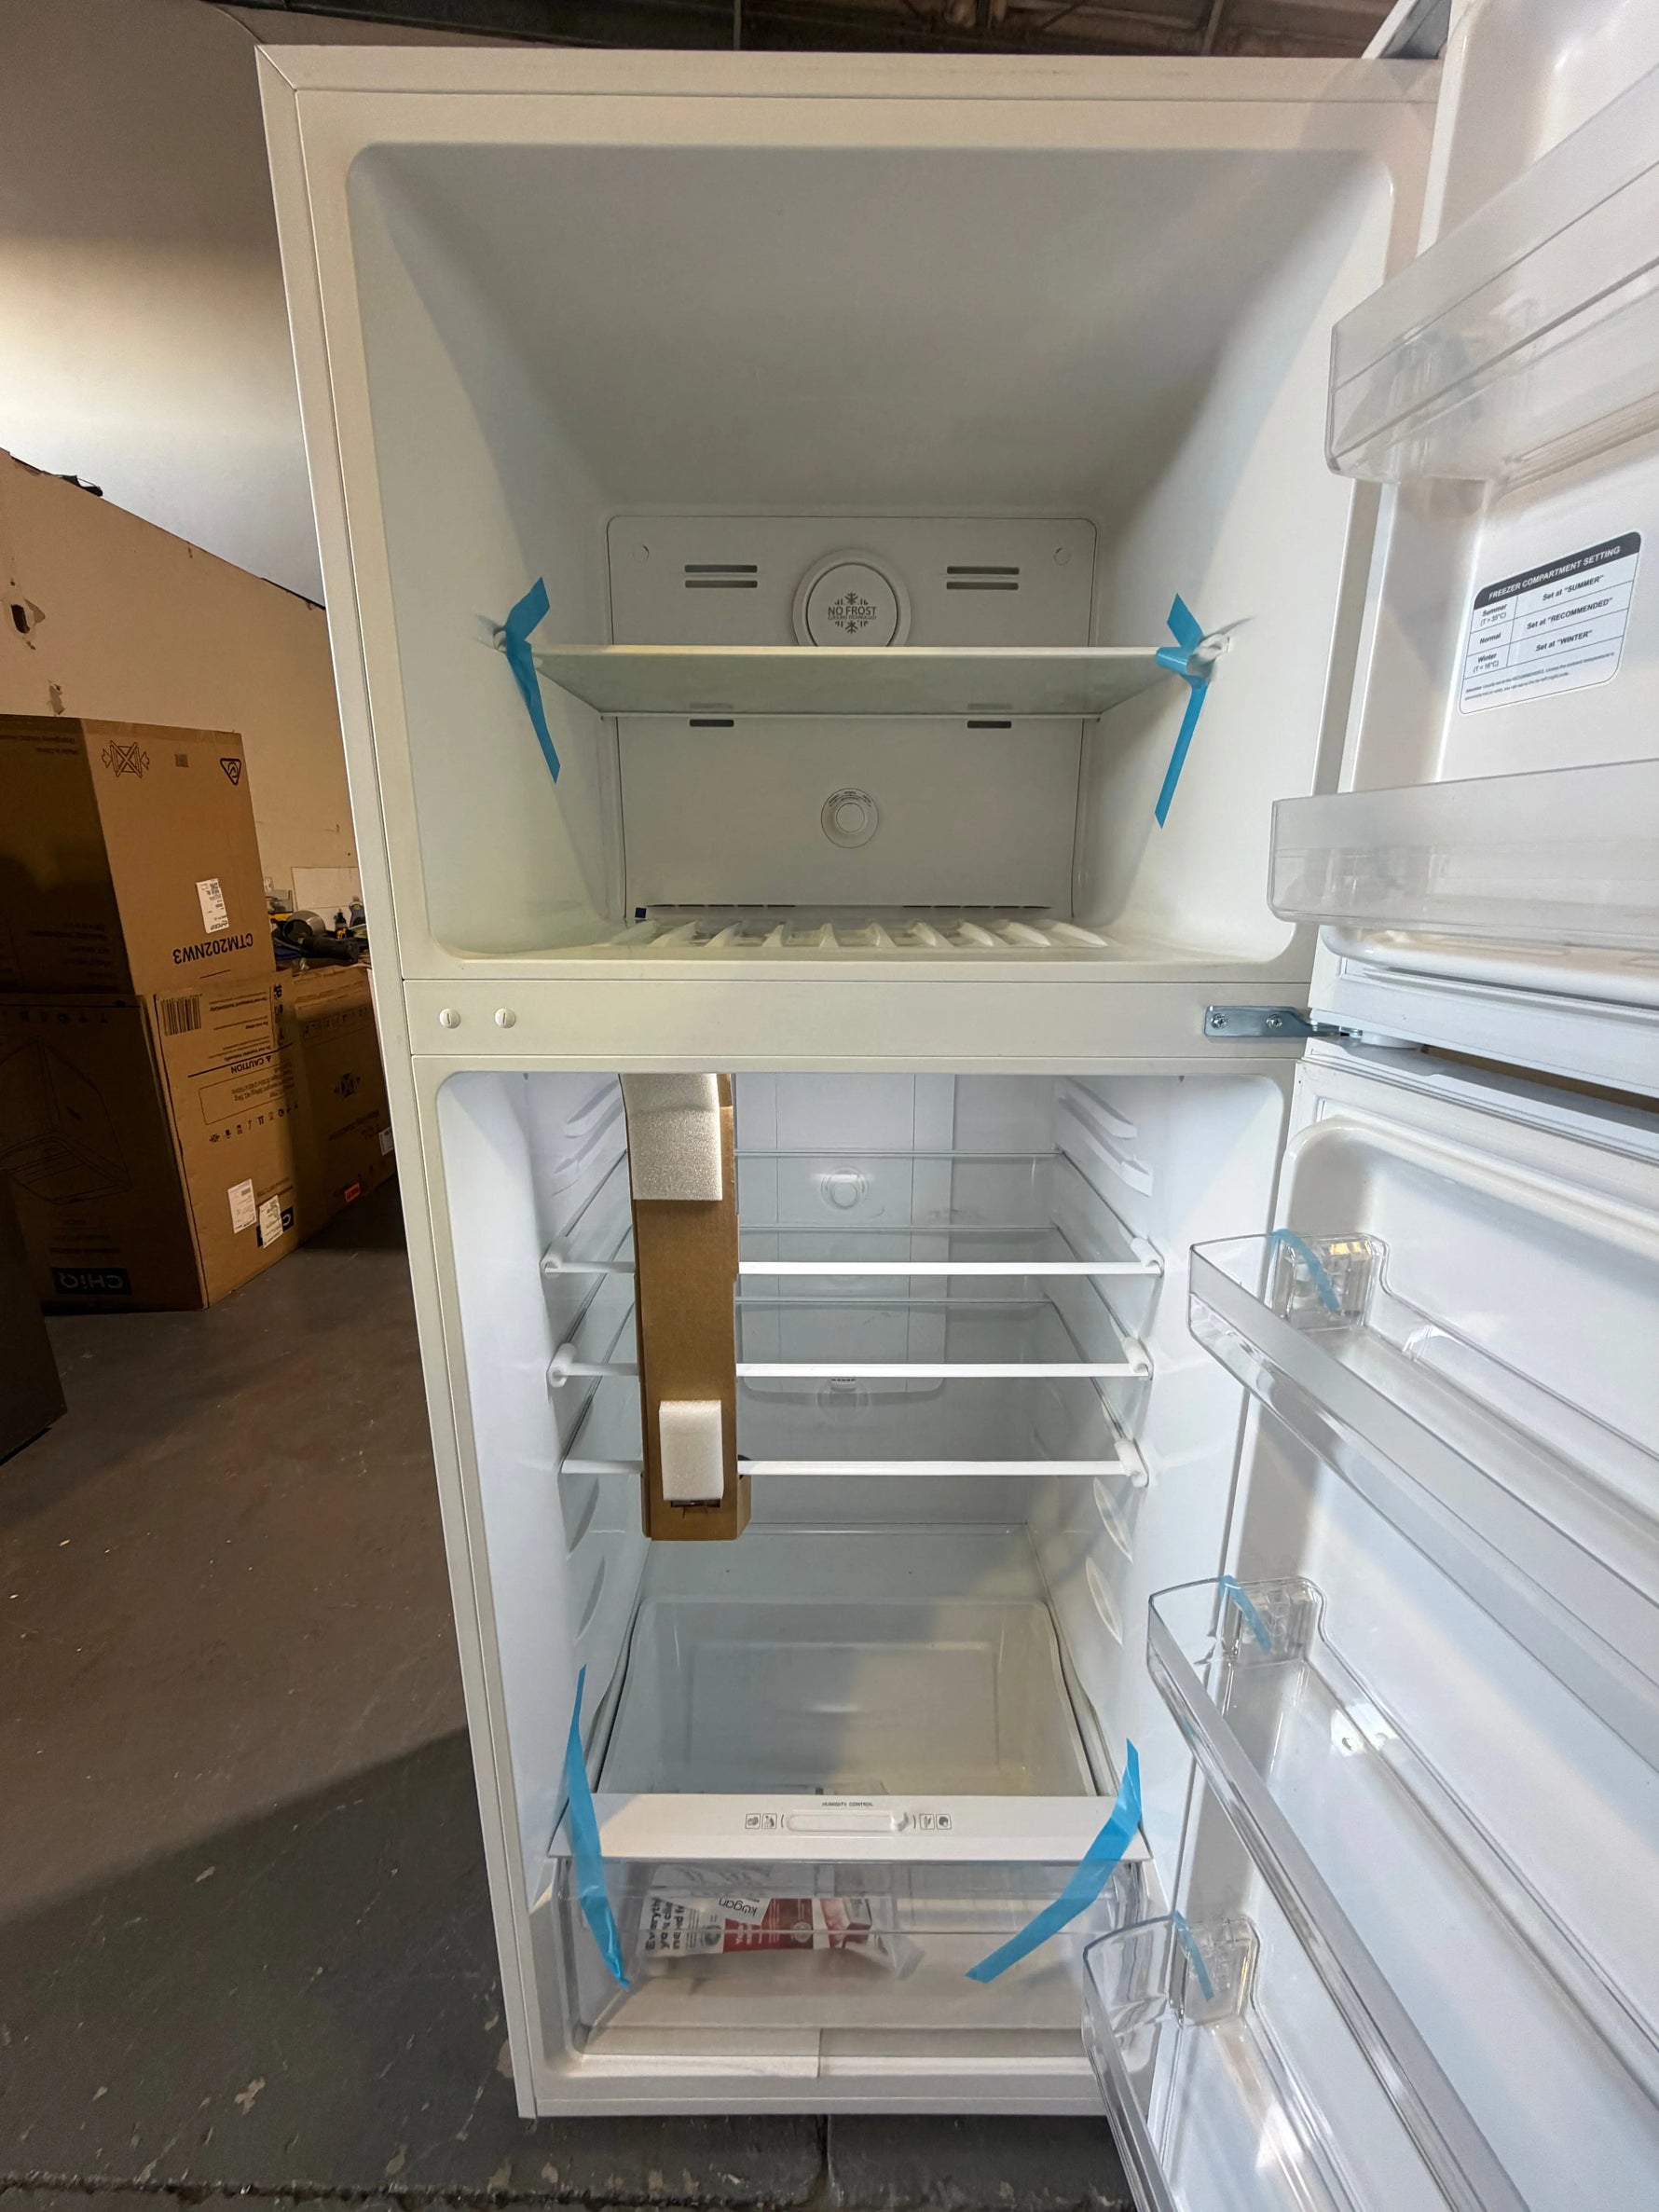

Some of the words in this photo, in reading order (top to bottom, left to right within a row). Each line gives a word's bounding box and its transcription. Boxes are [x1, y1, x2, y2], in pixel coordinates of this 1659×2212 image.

[1488, 583, 1522, 599] FREEZER
[1522, 560, 1582, 588] COMPARTMENT
[1583, 545, 1621, 566] SETTING
[1542, 592, 1554, 601] Set
[828, 606, 843, 616] NO
[845, 606, 877, 616] FROST
[1482, 604, 1507, 617] Summer
[1527, 621, 1539, 630] Set
[1479, 632, 1501, 645] Normal
[1536, 643, 1547, 652] Set
[1477, 653, 1497, 664] Winter
[172, 933, 254, 964] CTM202NW3
[230, 1057, 264, 1074] CAUTION
